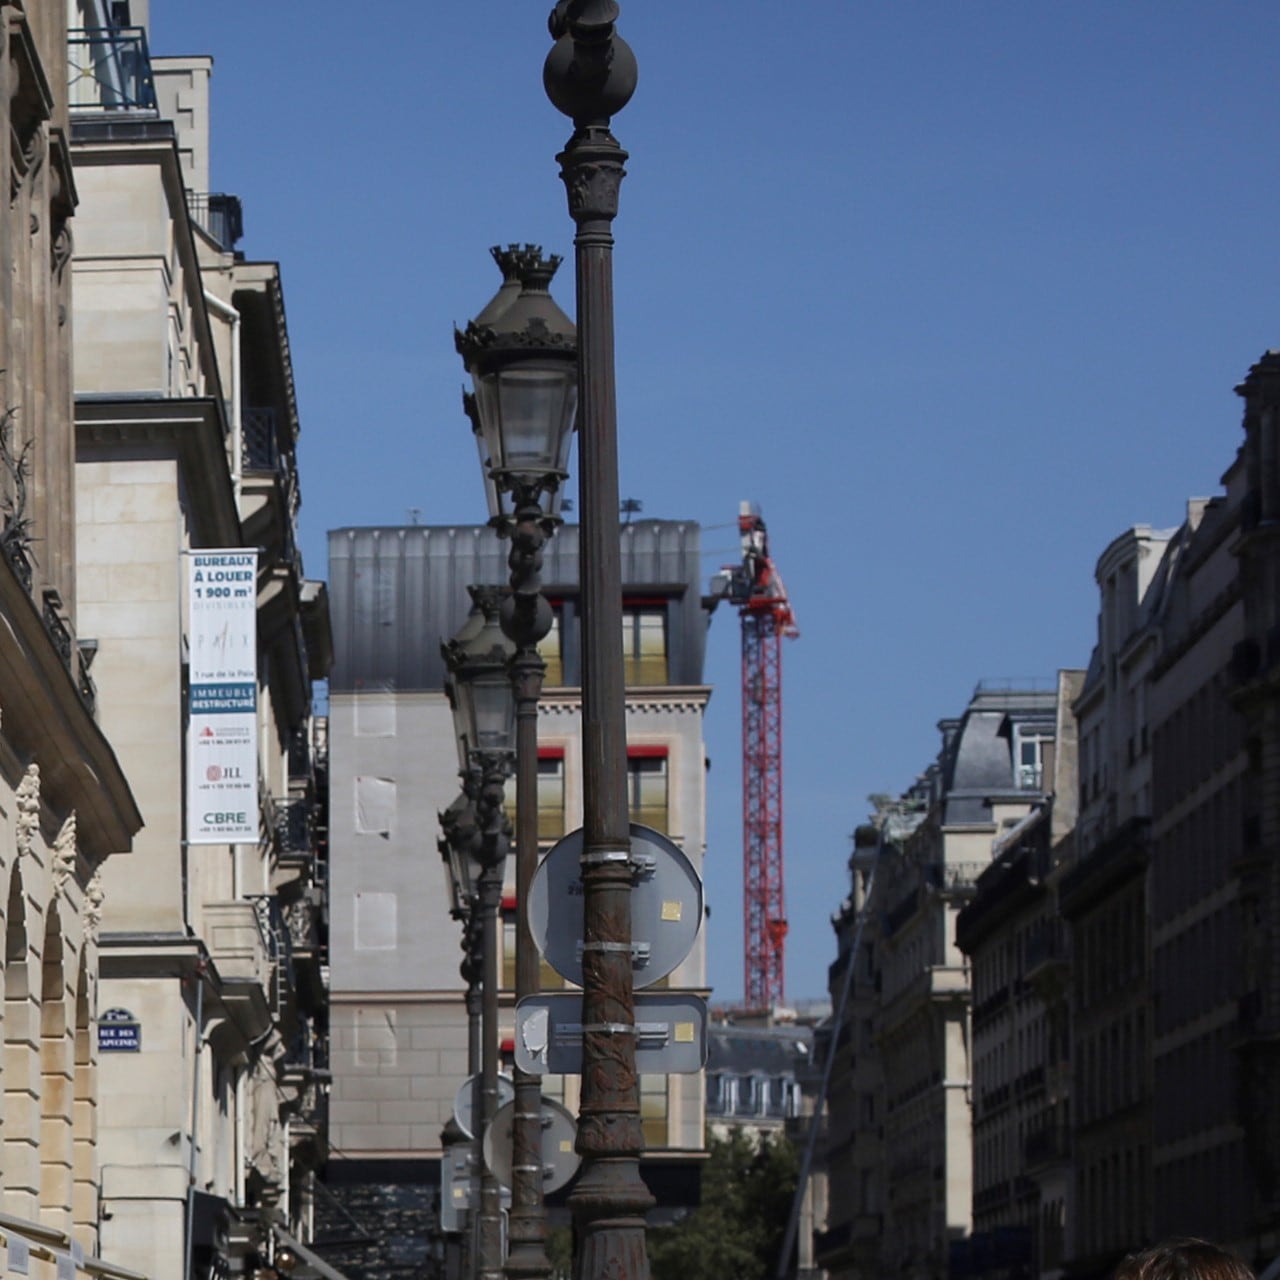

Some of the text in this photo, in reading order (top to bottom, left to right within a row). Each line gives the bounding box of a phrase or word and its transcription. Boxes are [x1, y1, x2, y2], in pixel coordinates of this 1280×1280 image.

[194, 556, 253, 566] BUREAUX
[194, 569, 253, 582] À LOUER
[195, 588, 202, 598] 1
[206, 587, 230, 598] 900
[193, 688, 255, 697] IMMEUBLE
[223, 768, 242, 779] JLL
[203, 812, 247, 824] CBRE
